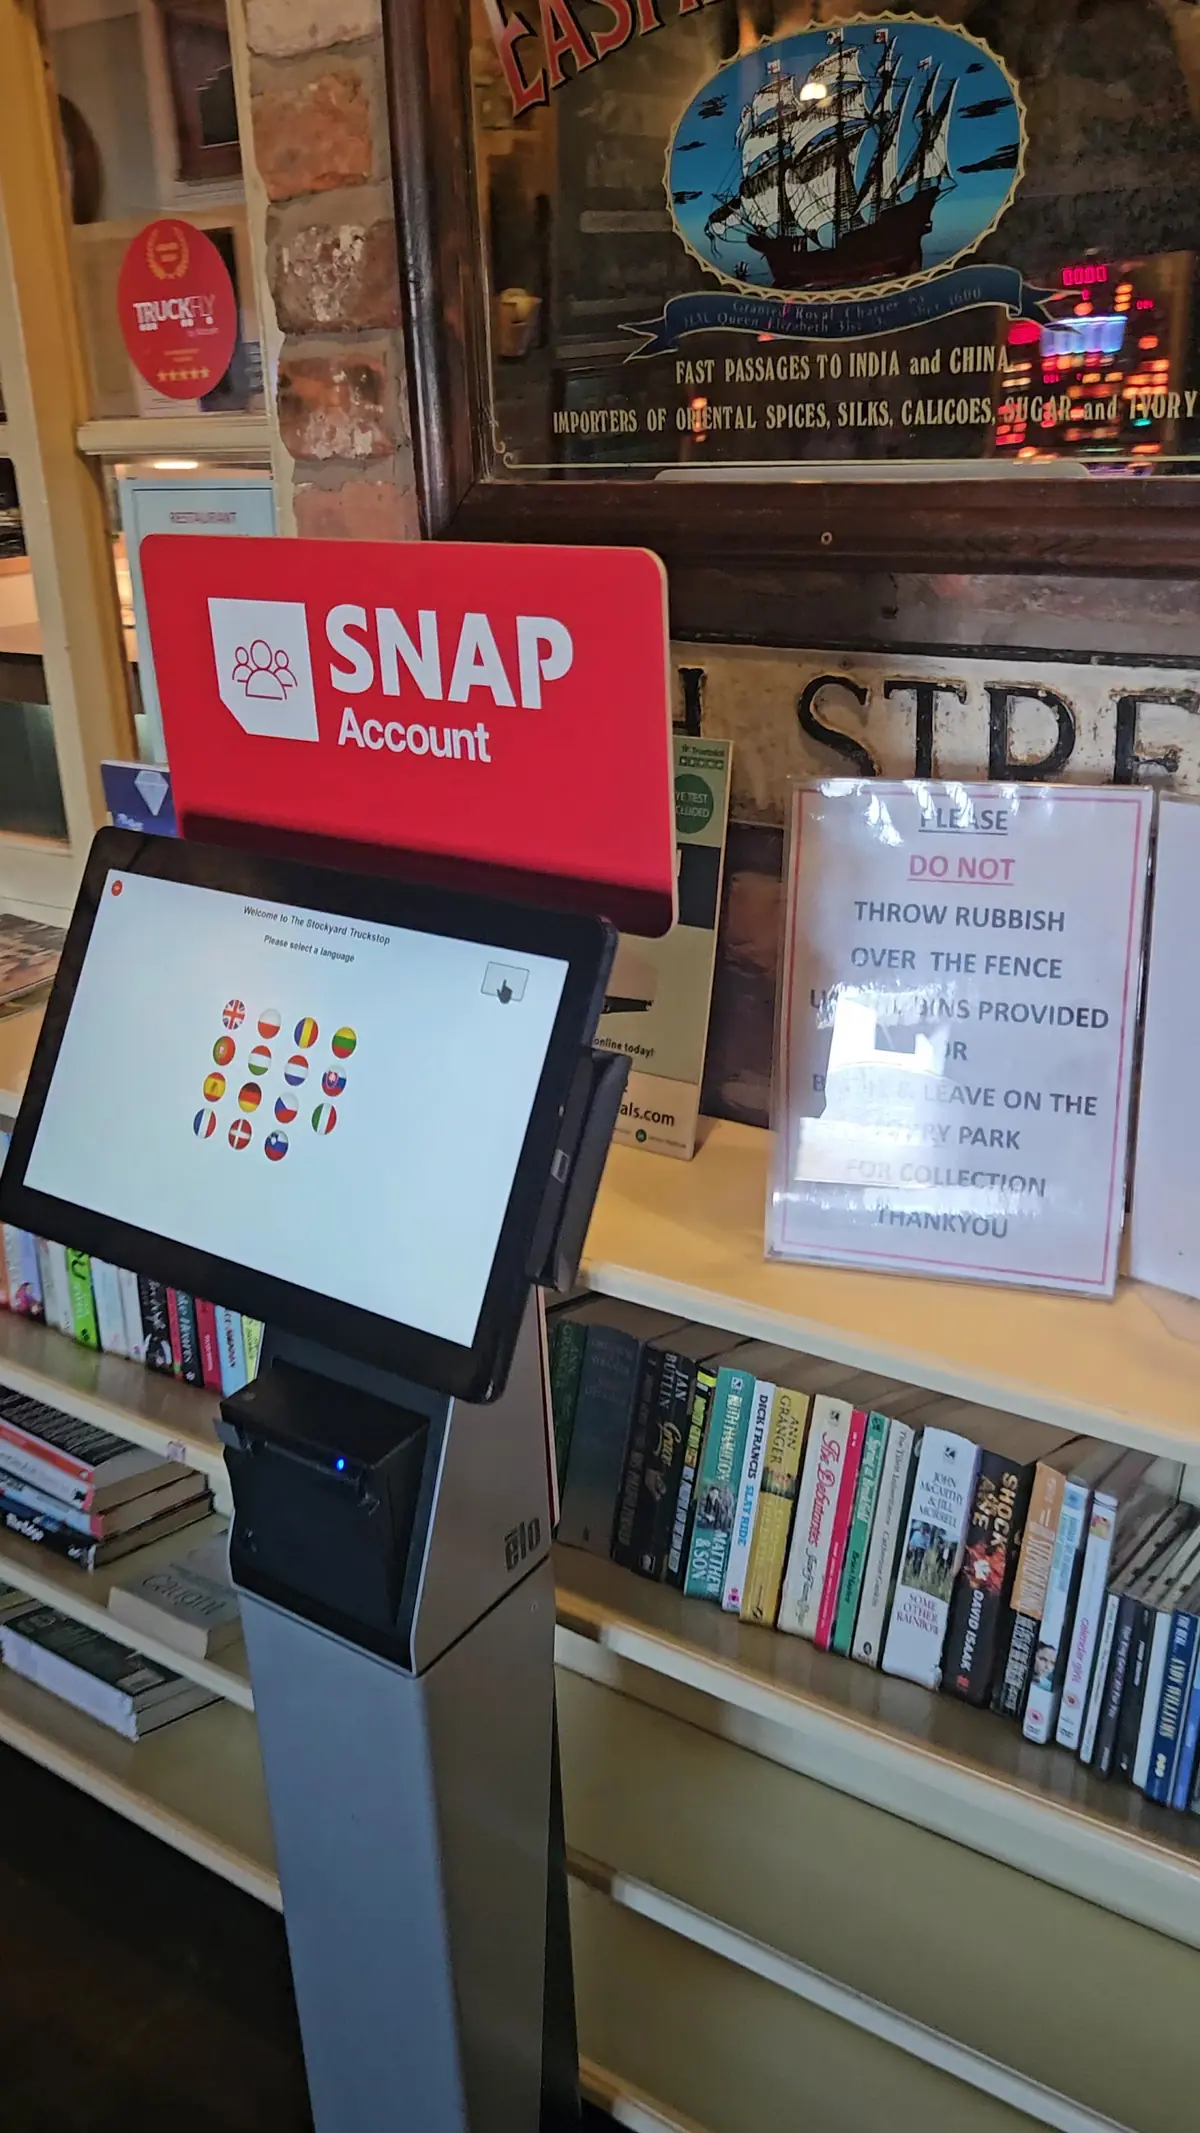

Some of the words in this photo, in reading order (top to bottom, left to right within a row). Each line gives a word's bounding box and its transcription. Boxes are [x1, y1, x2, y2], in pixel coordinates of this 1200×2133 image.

[133, 293, 216, 323] TRUCKFLY
[717, 311, 759, 327] Queen
[767, 317, 829, 334] Elizabeth
[949, 287, 982, 305] 1600
[795, 304, 834, 320] Royal
[844, 301, 899, 318] Charter
[676, 360, 715, 384] FAST
[725, 355, 811, 382] PASSAGES
[816, 352, 841, 378] TO
[849, 350, 900, 377] INDIA
[909, 348, 941, 375] and
[553, 409, 638, 433] IMPORTERS
[647, 408, 667, 431] OF
[676, 404, 757, 432] ORIENTAL
[766, 403, 832, 430] SPICES,
[837, 401, 894, 429] SILKS,
[901, 397, 996, 426] CALICOES,
[1083, 395, 1117, 421] and
[1129, 390, 1195, 420] IVORY
[326, 604, 574, 710] SNAP
[338, 706, 492, 763] Account
[909, 854, 949, 878] DO
[957, 856, 1016, 881] NOT
[243, 905, 279, 921] Welcome
[279, 913, 289, 922] to
[290, 914, 305, 927] The
[306, 918, 349, 937] Stockyard
[349, 927, 391, 946] Truckstop
[854, 900, 948, 925] THROW
[955, 906, 1065, 933] RUBBISH
[263, 934, 289, 947] Please
[289, 940, 313, 954] select
[313, 947, 319, 955] a
[319, 947, 355, 963] language
[851, 947, 917, 970] OVER
[931, 952, 977, 974] THE
[984, 955, 1063, 979] FENCE
[978, 1001, 1109, 1029] PROVIDED
[594, 1036, 623, 1050] online
[624, 1042, 654, 1058] today!
[924, 1084, 996, 1107] LEAVE
[1003, 1089, 1041, 1111] ON
[1050, 1093, 1098, 1116] THE
[959, 1126, 1021, 1150] PARK
[846, 1158, 891, 1181] FOR
[900, 1163, 1046, 1197] COLLECTION
[877, 1205, 1009, 1239] THANKYOU
[658, 1352, 677, 1409] BUTLIN
[674, 1369, 688, 1400] JAN
[755, 1394, 768, 1425] DICK
[770, 1394, 792, 1464] GRANGER
[785, 1416, 800, 1449] ANN
[715, 1425, 736, 1481] HAMILTON
[747, 1426, 764, 1479] FRANCIS
[820, 1431, 843, 1462] The
[933, 1470, 957, 1488] JOHN
[742, 1484, 754, 1514] SLAY
[806, 1463, 836, 1546] Debutantes
[989, 1472, 1019, 1546] SHOCK
[694, 1537, 709, 1549] &
[737, 1515, 750, 1546] RIDE
[690, 1549, 708, 1580] SON
[706, 1530, 727, 1593] MATTHEW
[902, 1602, 939, 1622] OTHER
[908, 1592, 938, 1610] SOME
[967, 1588, 984, 1628] DAVID
[896, 1611, 940, 1636] RAINBOW
[960, 1629, 977, 1670] ISAAK
[1167, 1656, 1186, 1683] ANDY
[1159, 1684, 1182, 1739] WILLIAMS
